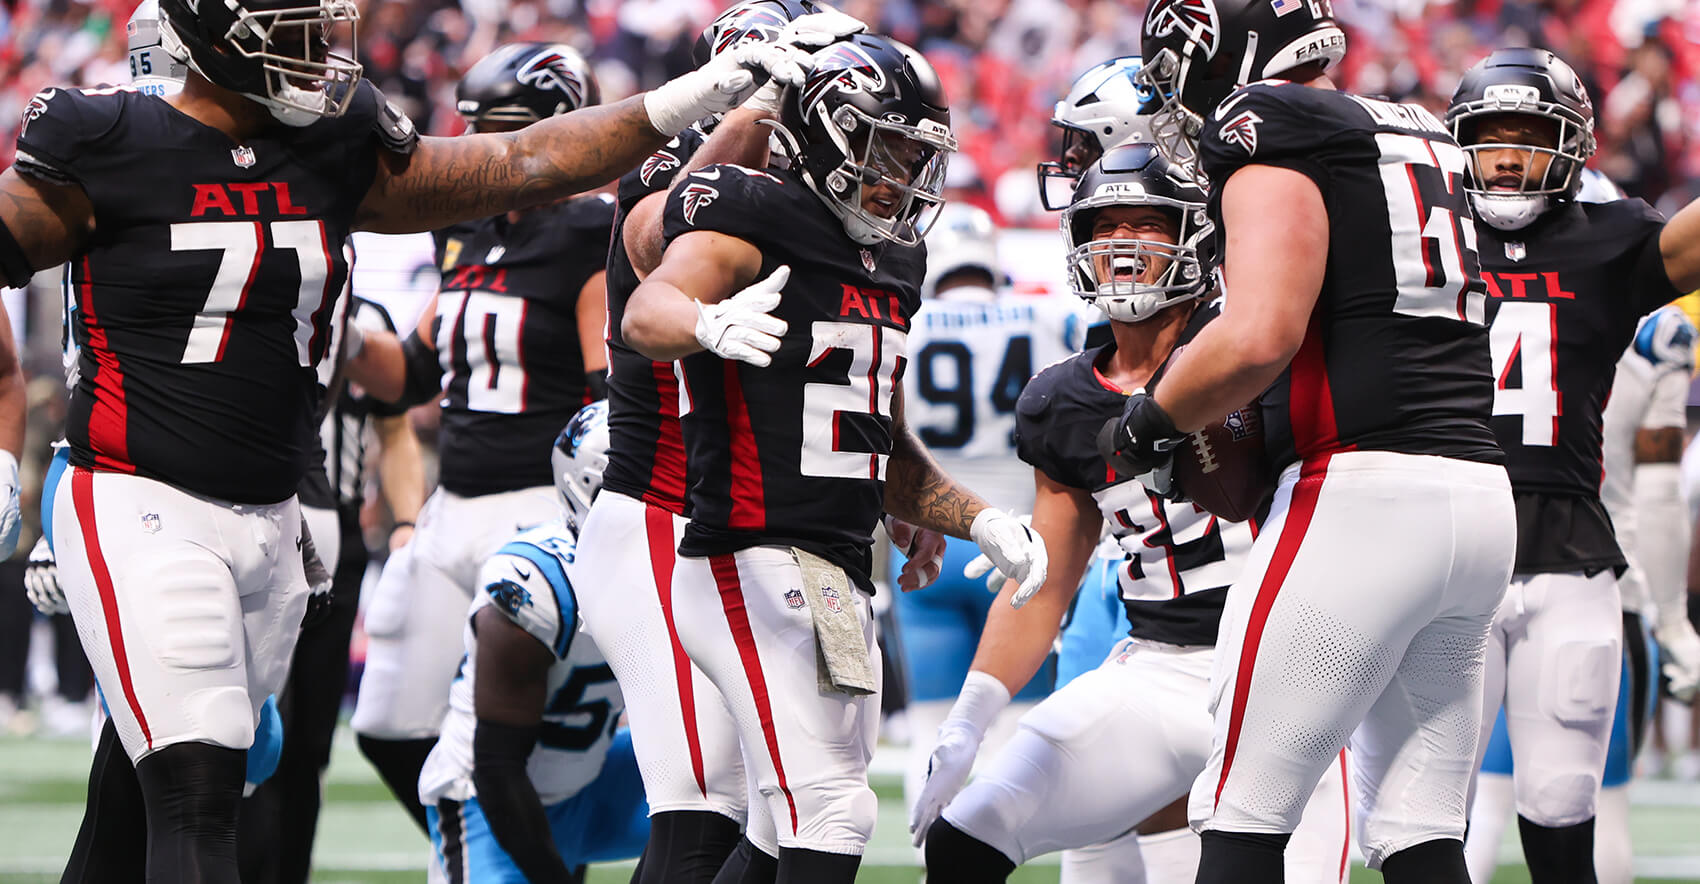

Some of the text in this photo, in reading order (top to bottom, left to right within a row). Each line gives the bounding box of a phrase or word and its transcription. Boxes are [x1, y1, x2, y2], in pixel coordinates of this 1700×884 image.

[129, 52, 152, 77] 95
[190, 182, 307, 216] ATL
[1105, 184, 1131, 194] ATL
[170, 220, 333, 367] 71
[839, 284, 905, 326] ATL
[917, 334, 1034, 450] 94
[1490, 301, 1563, 447] 4
[538, 662, 622, 751] 5
